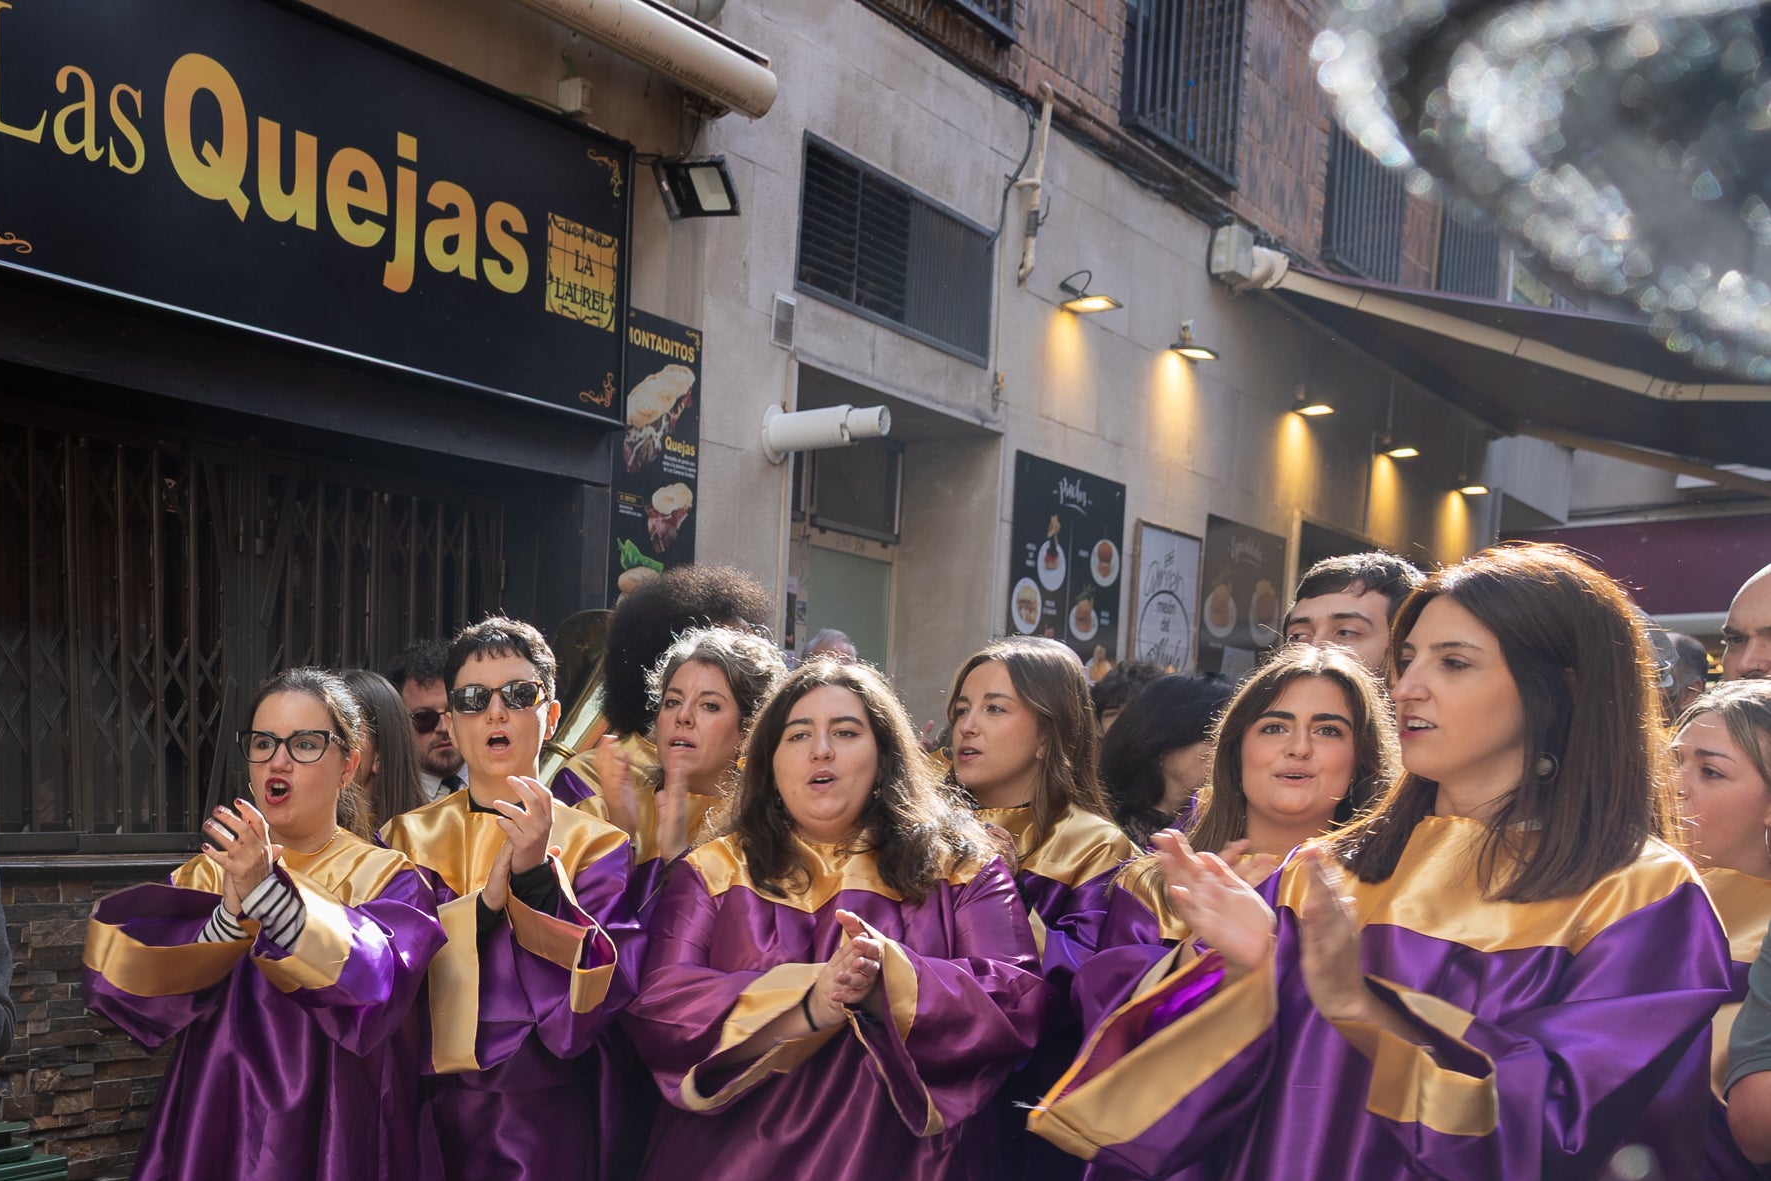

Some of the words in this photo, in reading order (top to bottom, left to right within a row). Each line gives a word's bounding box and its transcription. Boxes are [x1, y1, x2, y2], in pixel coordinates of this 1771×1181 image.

[164, 52, 529, 294] Quejas
[574, 249, 594, 277] LA
[555, 277, 609, 314] LAUREL
[665, 435, 696, 458] Quejas
